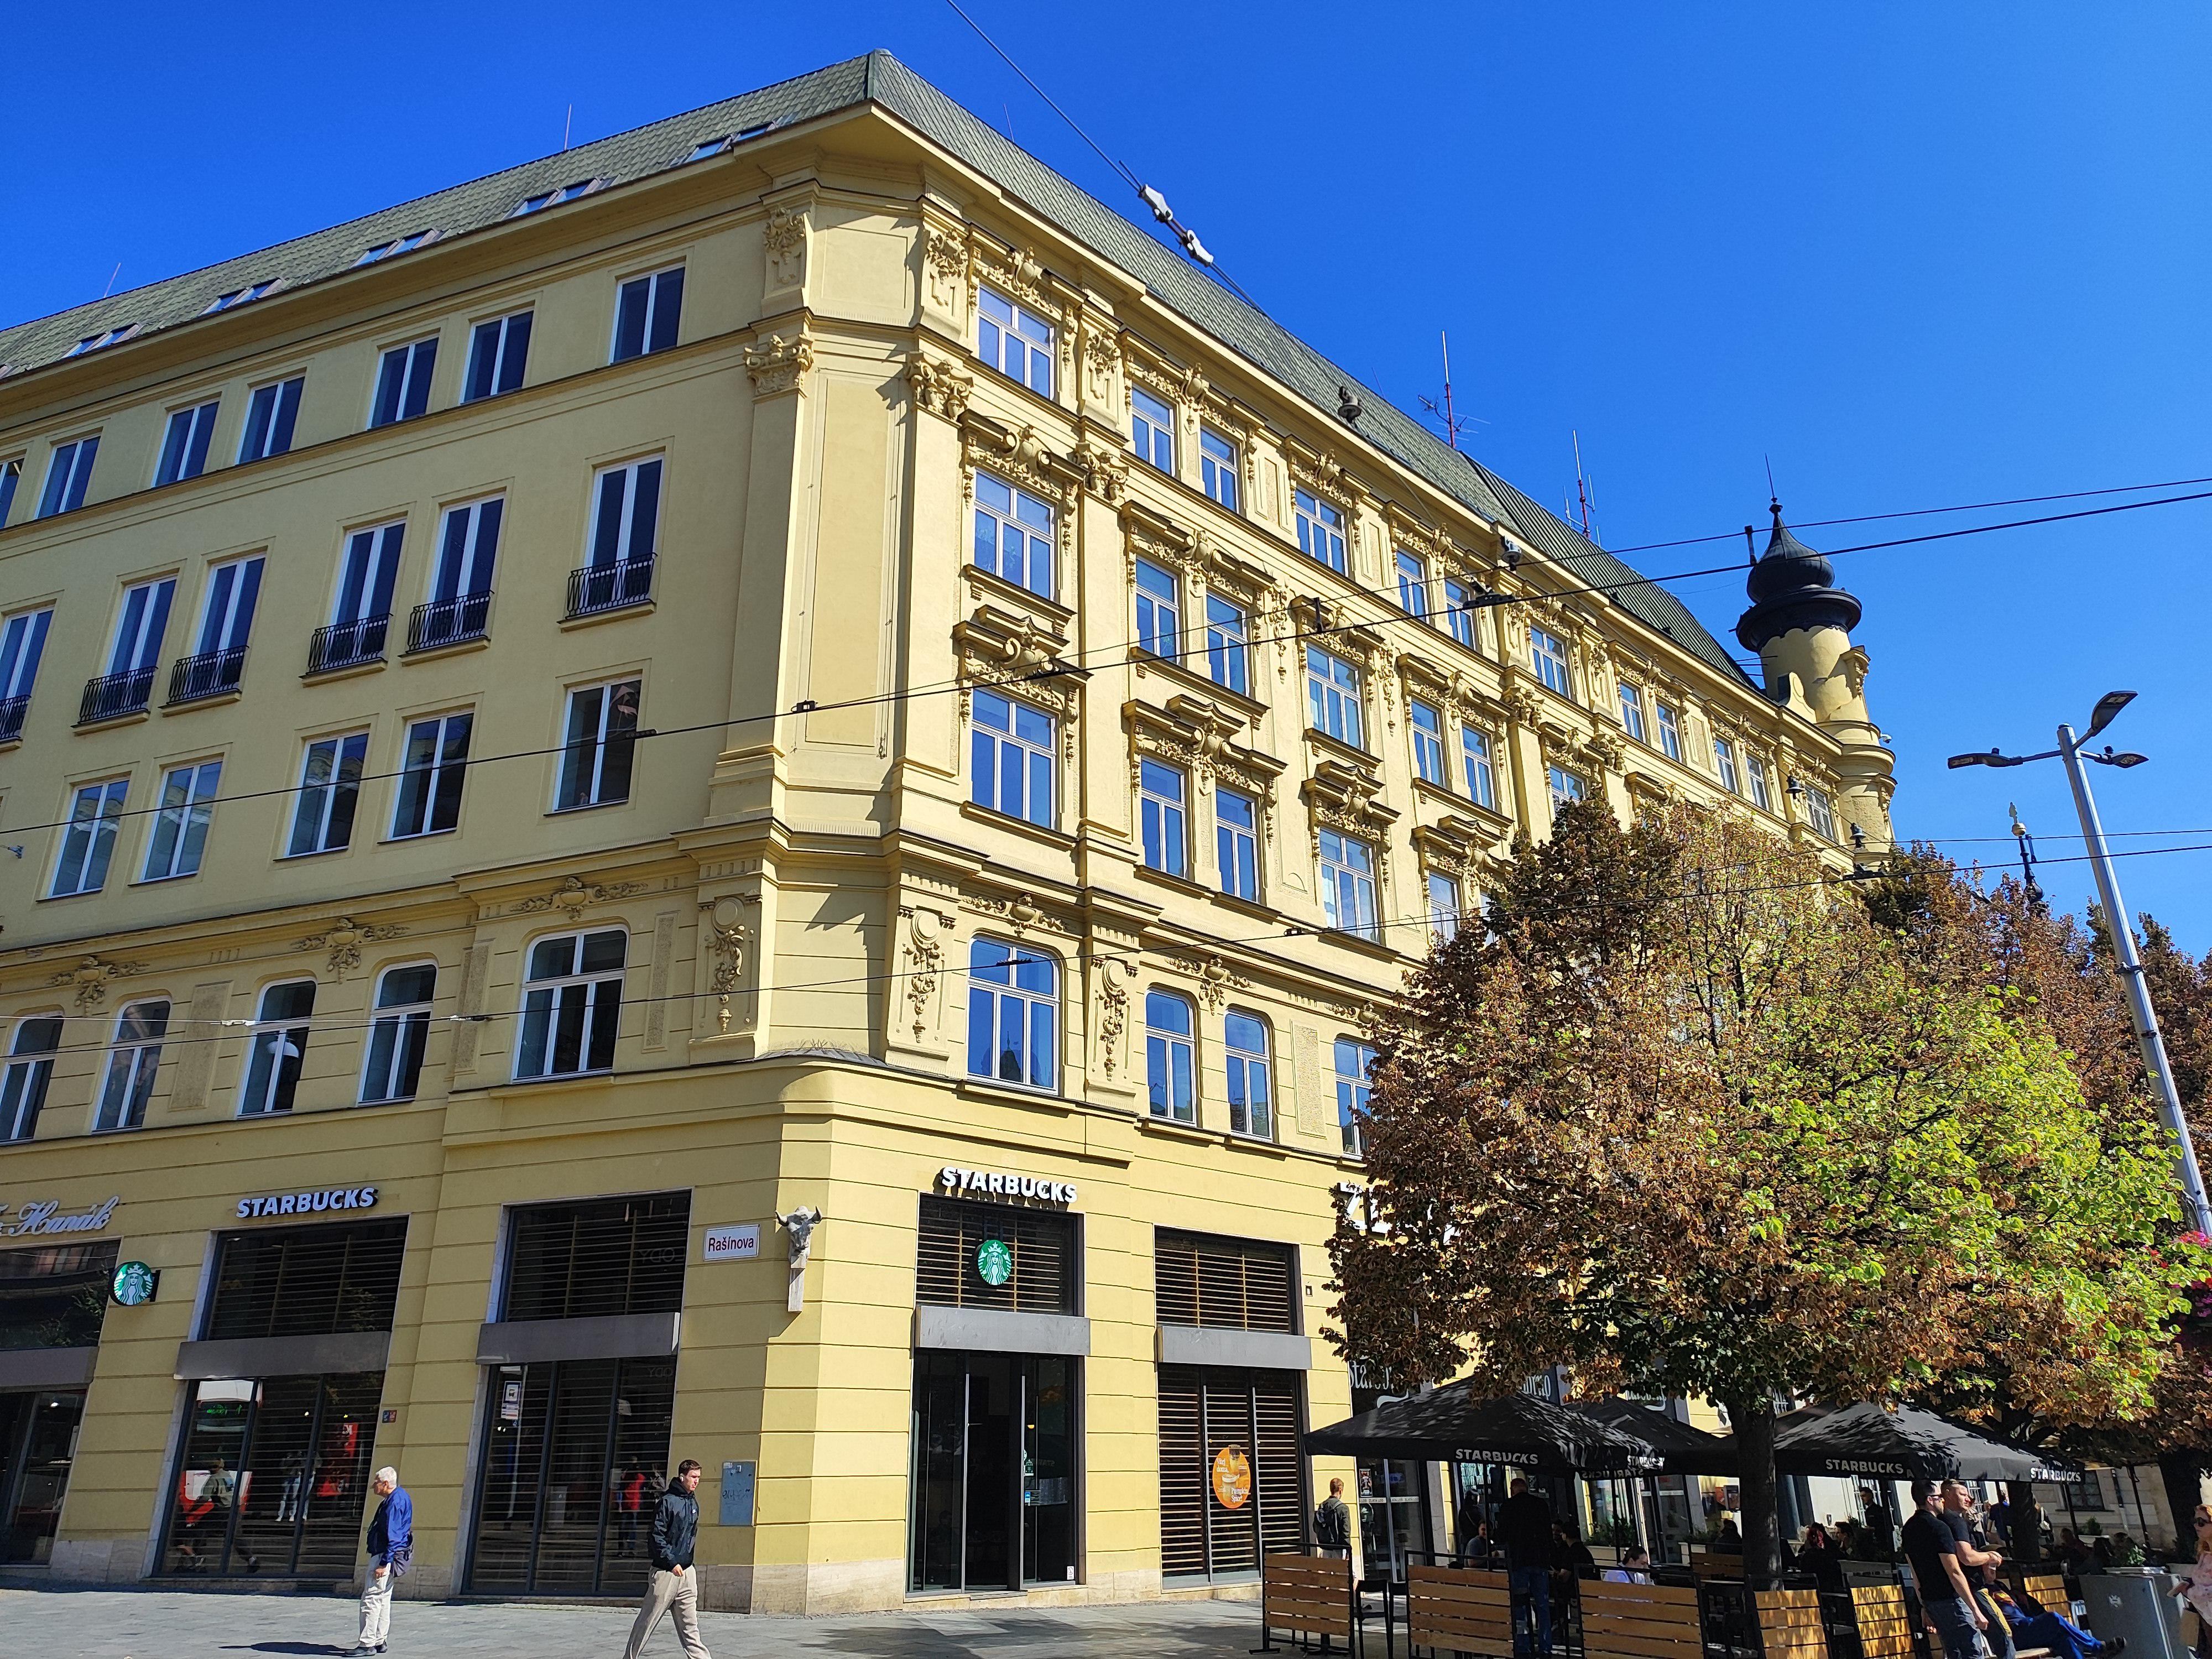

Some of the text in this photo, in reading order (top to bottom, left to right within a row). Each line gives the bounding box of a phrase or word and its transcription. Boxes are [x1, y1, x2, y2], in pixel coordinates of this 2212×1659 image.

[942, 1166, 1078, 1204] STARBUCKS
[236, 1187, 375, 1218] STARBUCKS
[8, 1196, 119, 1237] Hanák
[708, 1236, 754, 1252] Rašínova
[1455, 1448, 1538, 1464] STARBUCKS
[1826, 1459, 1903, 1474] STARBUCKS
[2031, 1467, 2081, 1482] STARBUCKS
